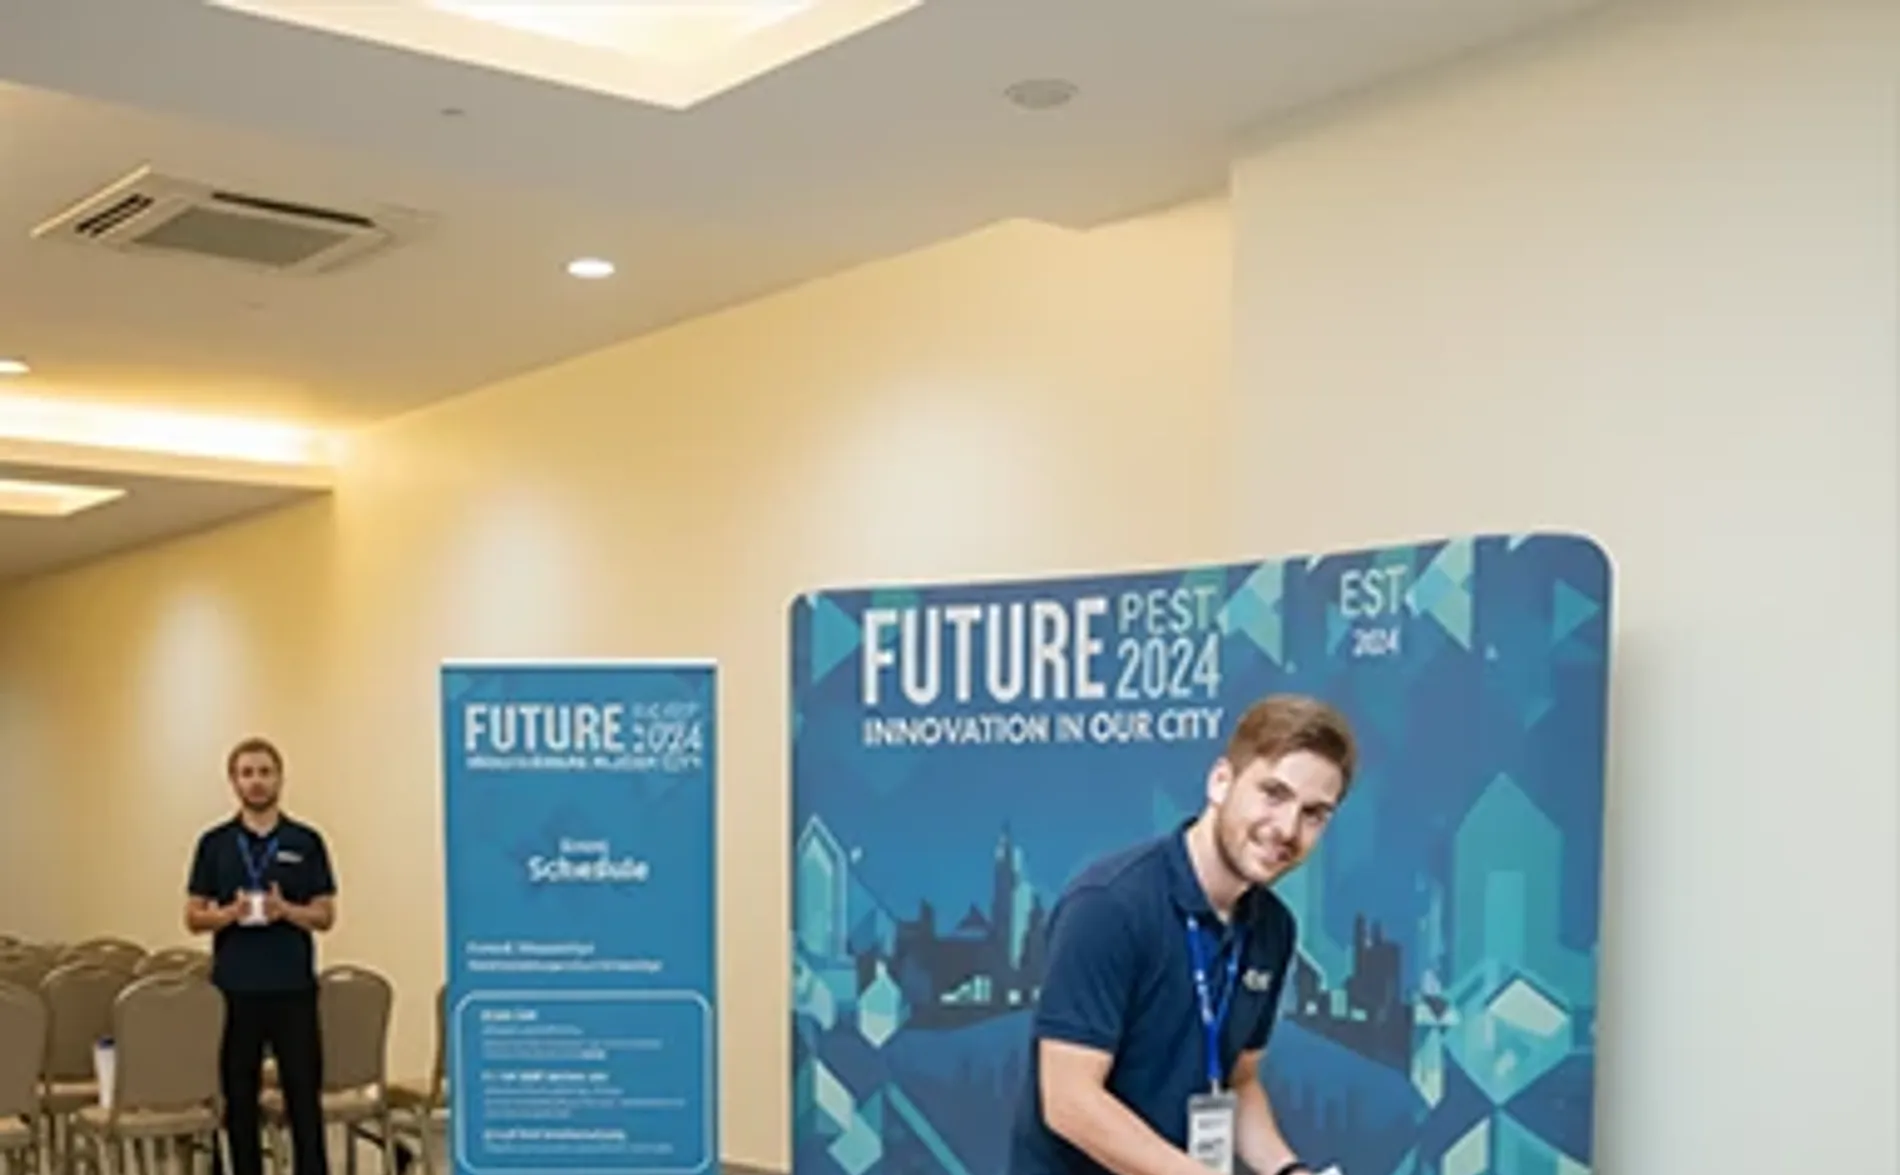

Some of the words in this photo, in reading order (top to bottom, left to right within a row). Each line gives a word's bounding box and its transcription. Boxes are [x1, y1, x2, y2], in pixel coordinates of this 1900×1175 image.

[1340, 564, 1408, 619] EST
[863, 597, 1107, 705] FUTURE
[1117, 584, 1218, 635] PEST
[1114, 632, 1223, 700] 2024
[464, 702, 625, 752] FUTURE
[863, 713, 1049, 746] INNOVATION
[1055, 713, 1084, 742] IN
[1088, 711, 1152, 742] OUR
[1157, 707, 1224, 741] CITY
